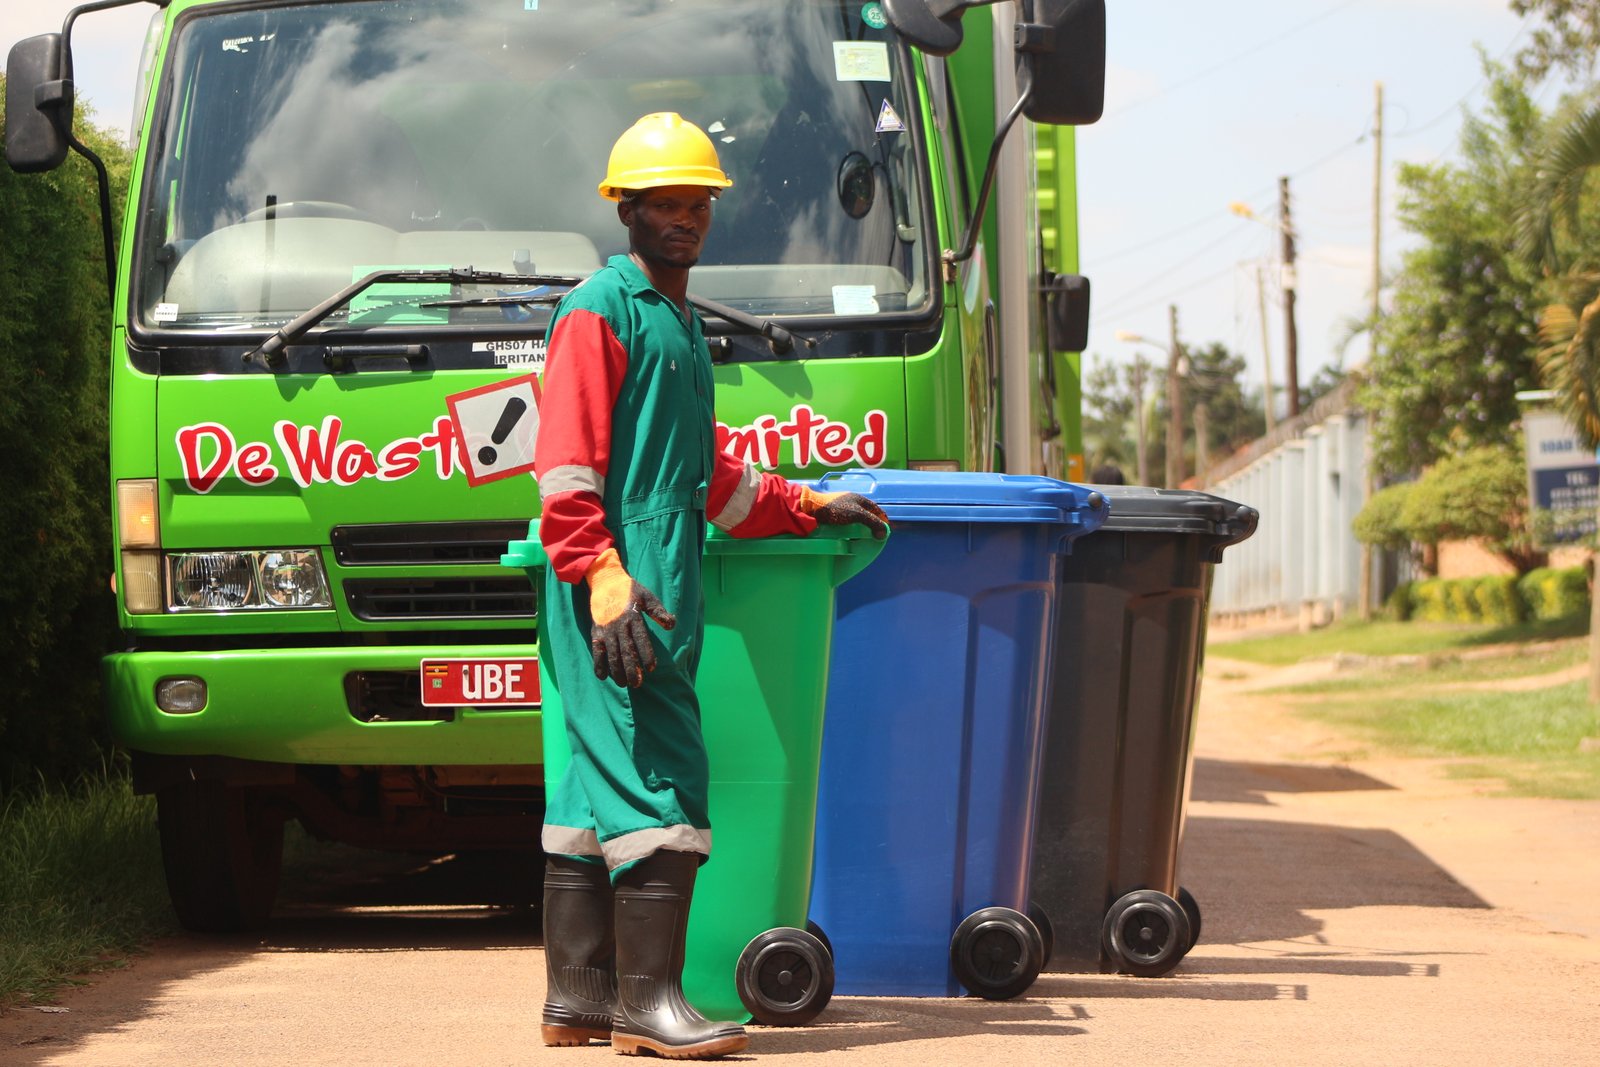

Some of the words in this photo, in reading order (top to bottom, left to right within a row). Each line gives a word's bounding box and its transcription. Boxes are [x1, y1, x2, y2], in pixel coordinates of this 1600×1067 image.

[486, 340, 527, 351] GHS07
[532, 340, 546, 349] HA
[495, 353, 546, 364] IRRITAN
[716, 404, 887, 470] mited
[462, 664, 525, 699] UBE
